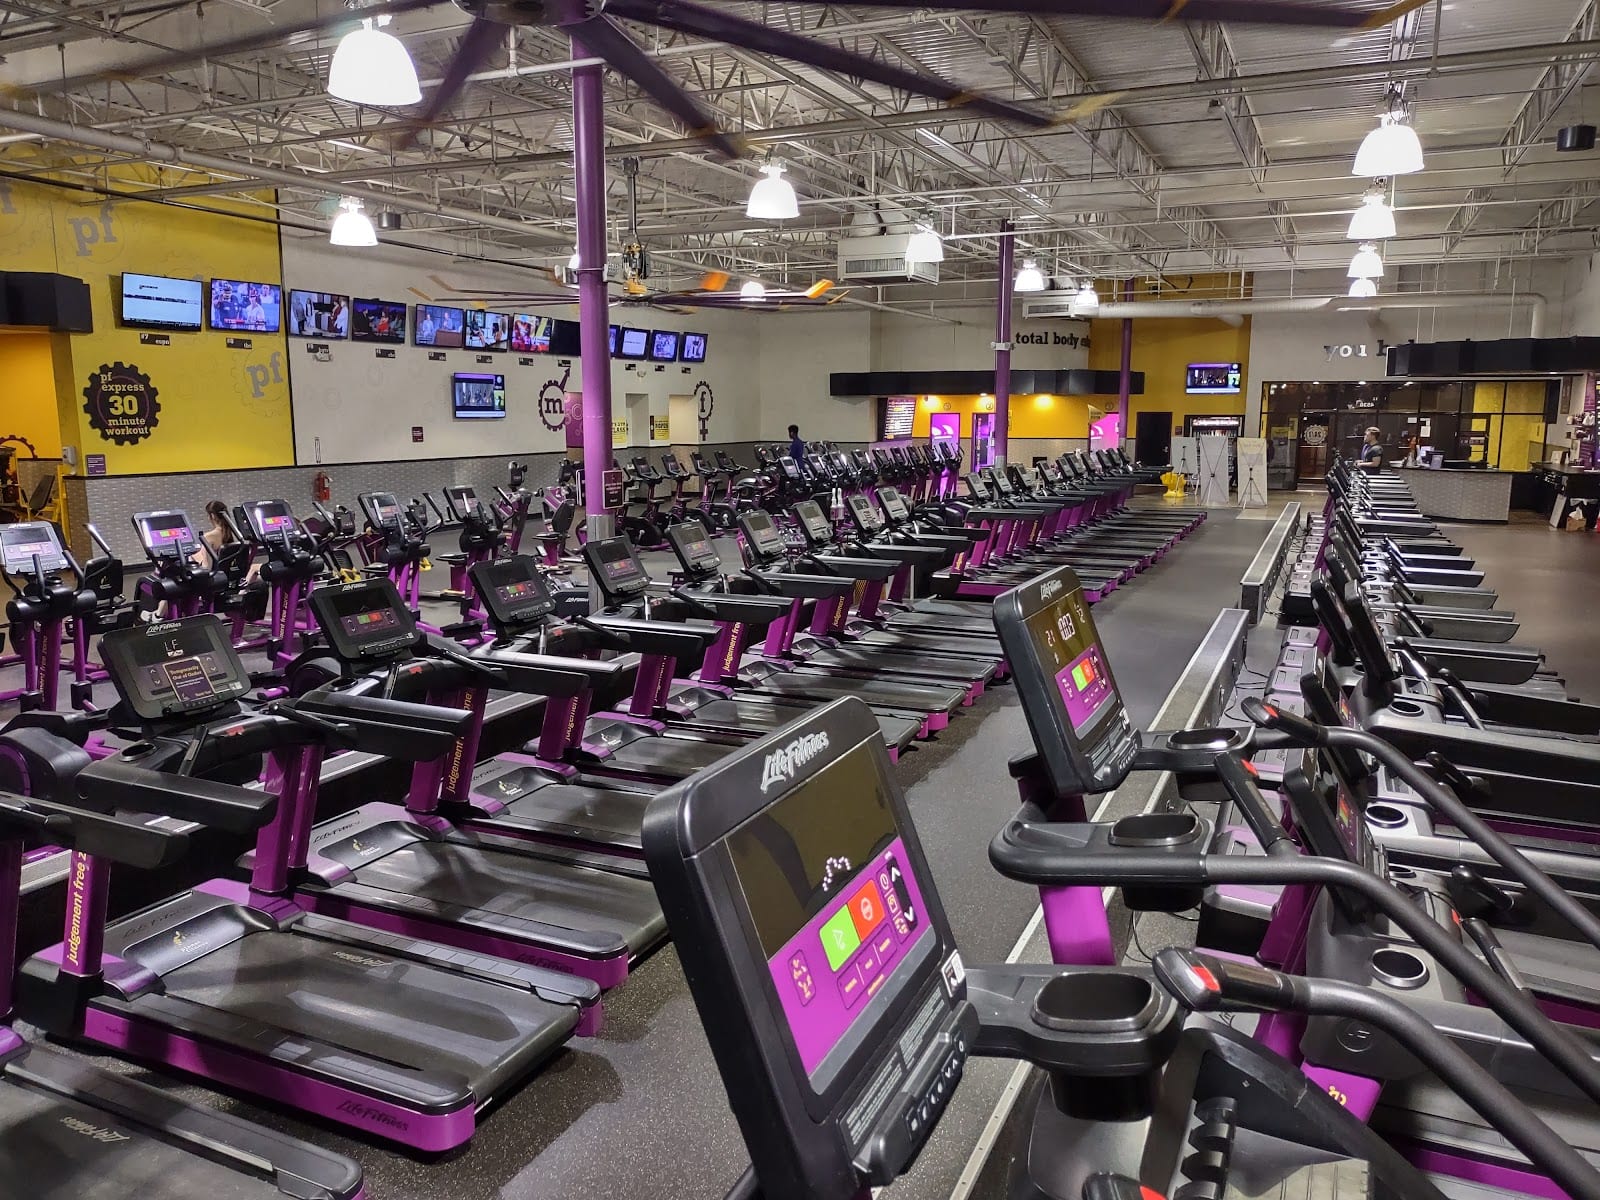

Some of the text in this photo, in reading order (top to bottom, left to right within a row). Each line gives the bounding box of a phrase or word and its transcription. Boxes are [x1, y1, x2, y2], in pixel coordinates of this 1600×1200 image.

[67, 201, 117, 256] pf
[1015, 332, 1048, 345] total
[1053, 332, 1079, 350] body
[1323, 344, 1368, 361] you
[100, 371, 113, 383] pf
[246, 351, 284, 398] pf
[101, 384, 145, 394] express
[108, 395, 139, 416] 30
[108, 416, 146, 426] minute
[105, 426, 149, 436] workout
[446, 740, 464, 795] judgement
[73, 862, 86, 890] free
[66, 892, 83, 966] judgement
